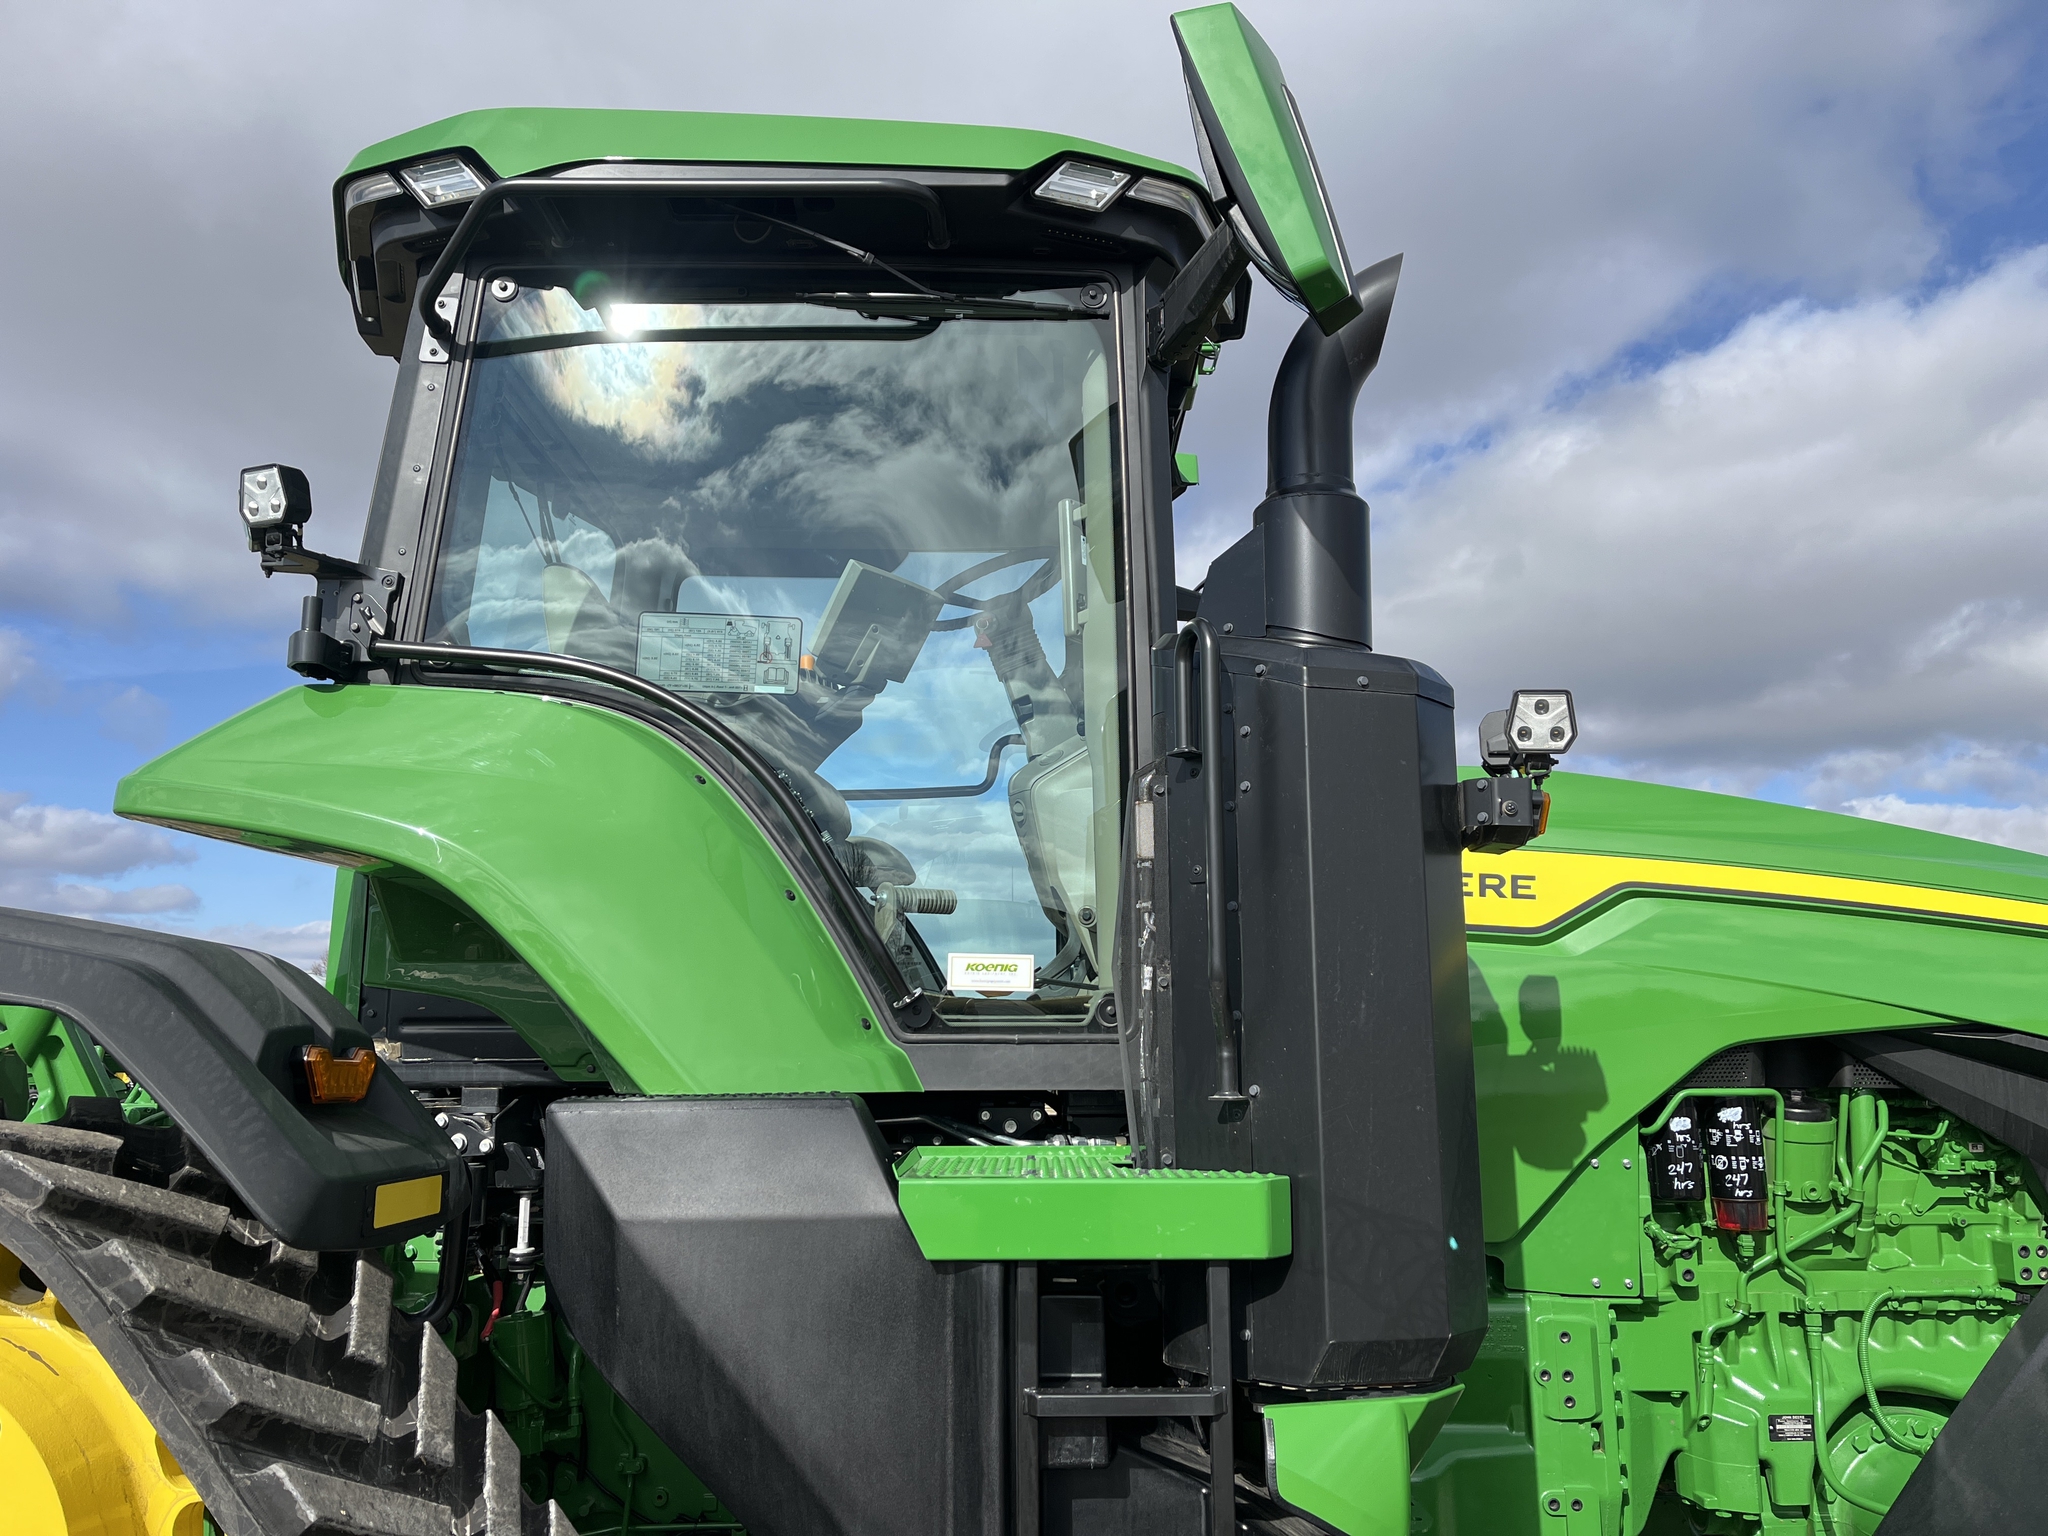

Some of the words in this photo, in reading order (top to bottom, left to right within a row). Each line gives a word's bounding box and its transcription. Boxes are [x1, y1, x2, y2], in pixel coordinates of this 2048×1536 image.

[1733, 1122, 1751, 1130] hrs
[1676, 1132, 1691, 1142] hrs
[1668, 1161, 1693, 1175] 247
[1674, 1178, 1694, 1190] hrs
[1725, 1173, 1749, 1187] 247
[1735, 1189, 1753, 1198] hrs
